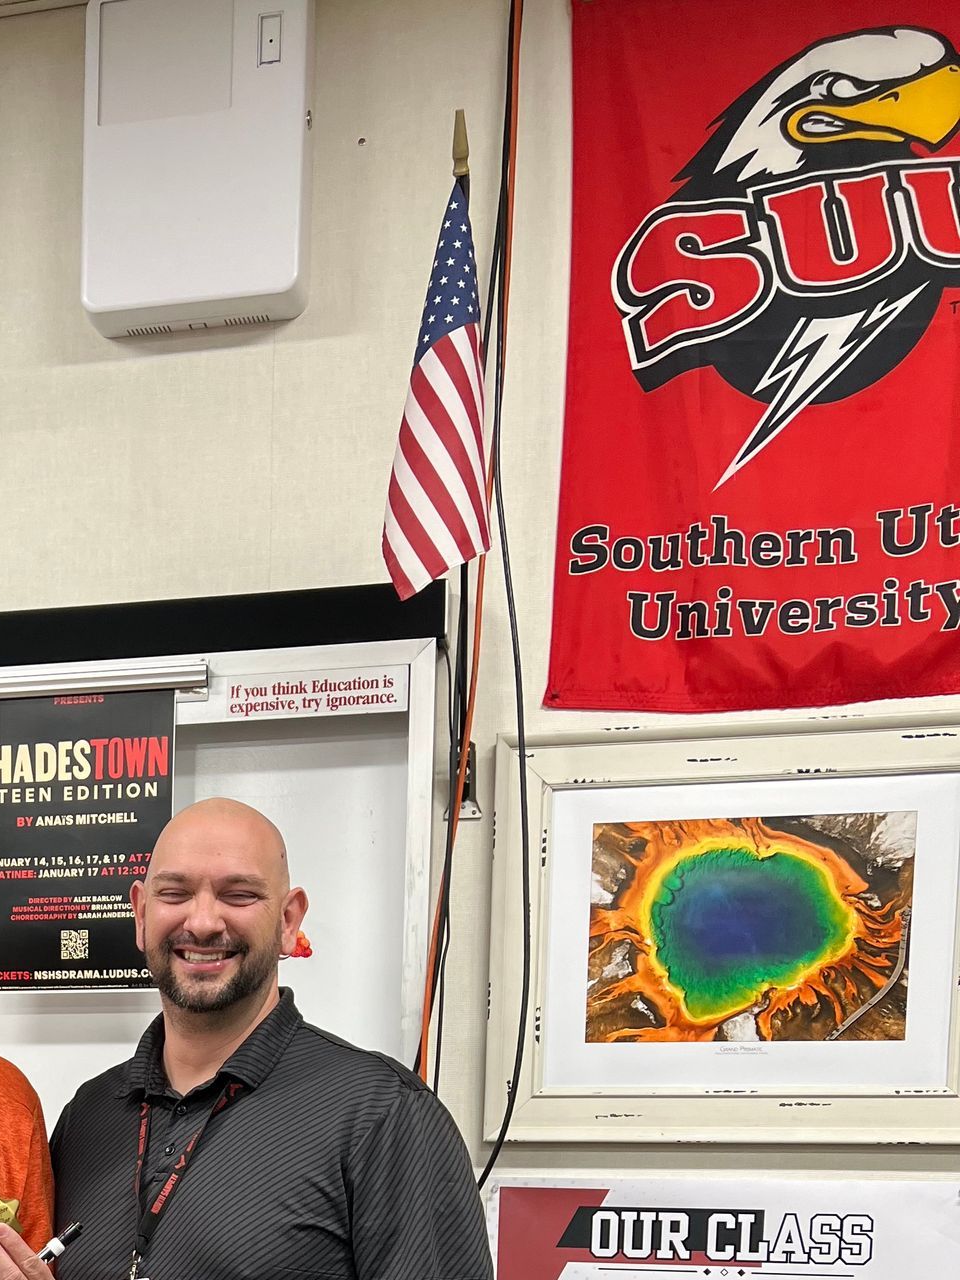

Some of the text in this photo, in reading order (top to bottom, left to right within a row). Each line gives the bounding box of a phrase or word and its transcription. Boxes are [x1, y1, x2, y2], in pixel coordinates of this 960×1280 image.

[568, 514, 858, 575] Southern
[627, 578, 960, 641] University
[231, 675, 393, 701] If you think Education is
[53, 694, 104, 705] PRESENTS
[230, 692, 397, 716] expensive, try ignorance.
[63, 781, 158, 802] EDITION
[16, 817, 33, 827] BY
[76, 812, 137, 825] MITCHELL
[113, 854, 125, 863] 19
[129, 853, 142, 862] AT
[38, 868, 84, 878] JANUARY
[88, 868, 98, 877] 17
[101, 867, 114, 876] AT
[118, 866, 146, 875] 12:30
[590, 1209, 874, 1265] OUR CLASS
